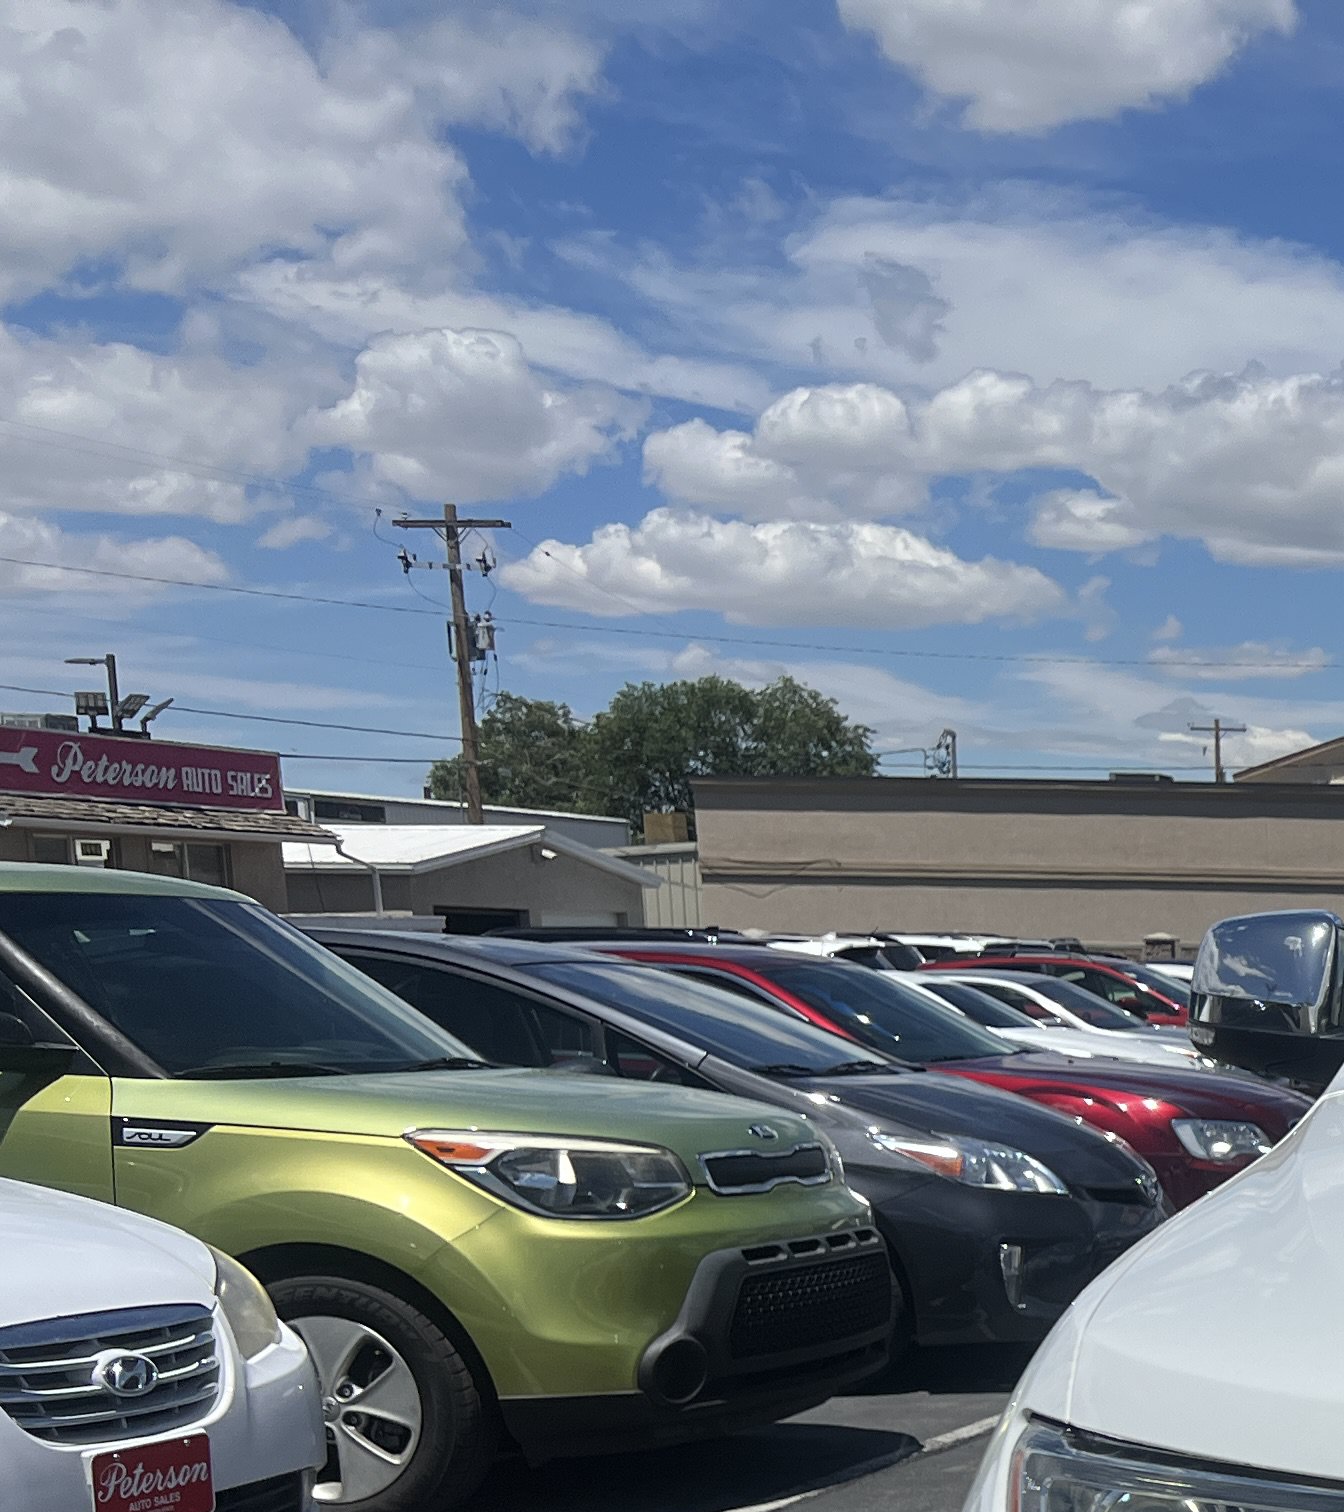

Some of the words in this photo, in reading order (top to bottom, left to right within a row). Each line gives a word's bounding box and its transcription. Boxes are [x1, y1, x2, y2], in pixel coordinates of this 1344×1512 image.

[51, 741, 178, 790] Peterson
[181, 766, 222, 794] AUTO
[227, 771, 273, 799] SALES
[97, 1461, 209, 1503] Peterson
[128, 1498, 152, 1512] AUTO
[153, 1491, 181, 1508] SALES
